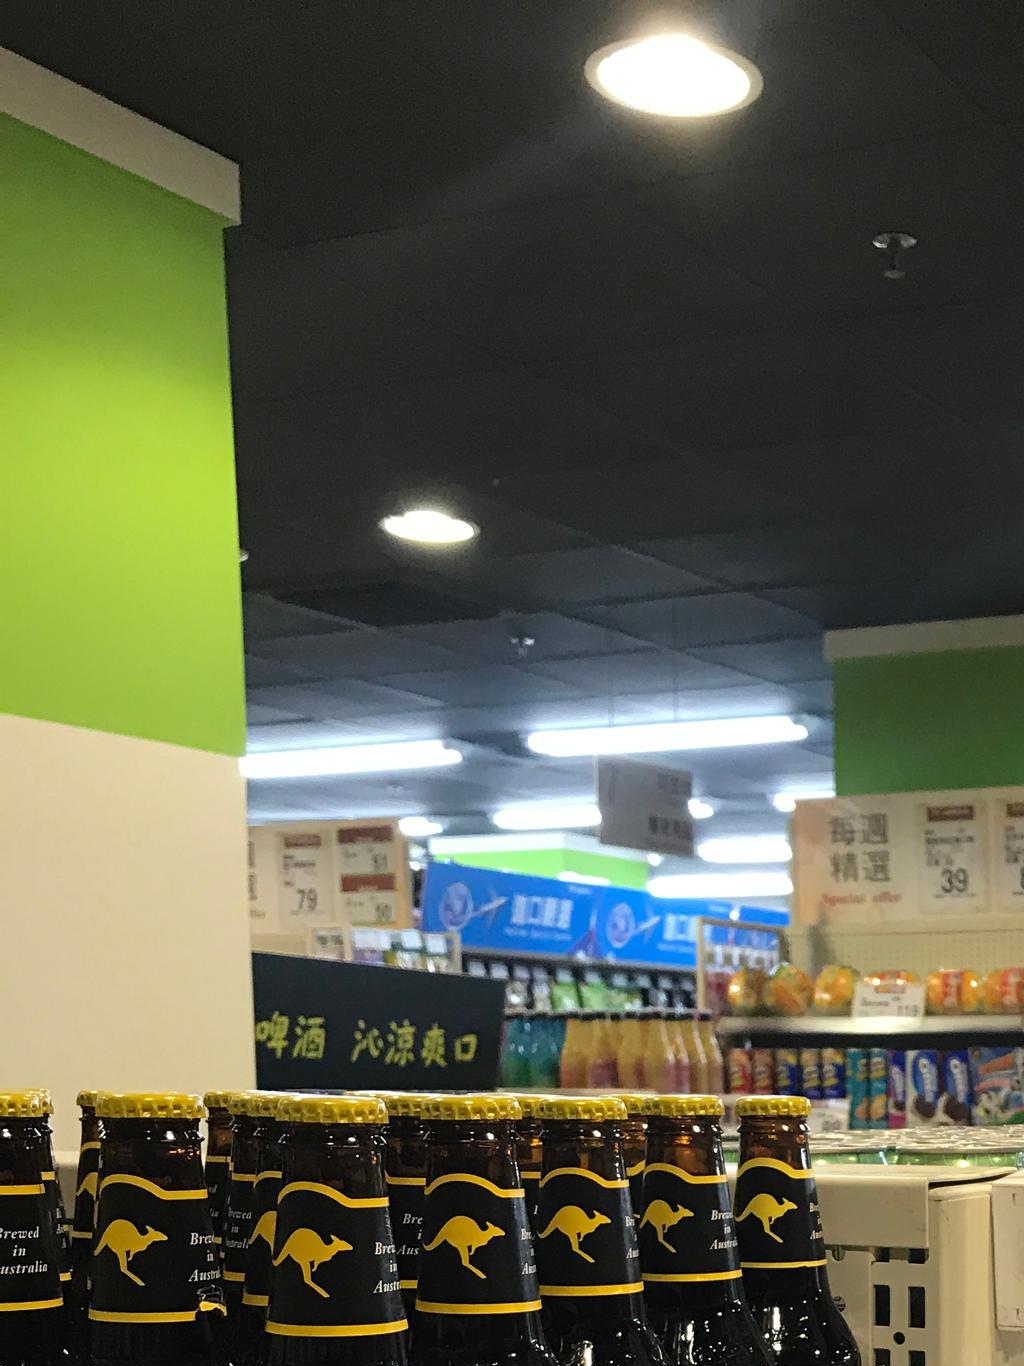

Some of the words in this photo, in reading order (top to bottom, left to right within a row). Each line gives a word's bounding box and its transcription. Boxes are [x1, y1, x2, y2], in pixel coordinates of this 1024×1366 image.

[829, 813, 889, 846] 每週
[830, 850, 891, 883] 精選
[941, 867, 968, 893] 39
[13, 1244, 26, 1257] in
[0, 1261, 48, 1275] ustralia
